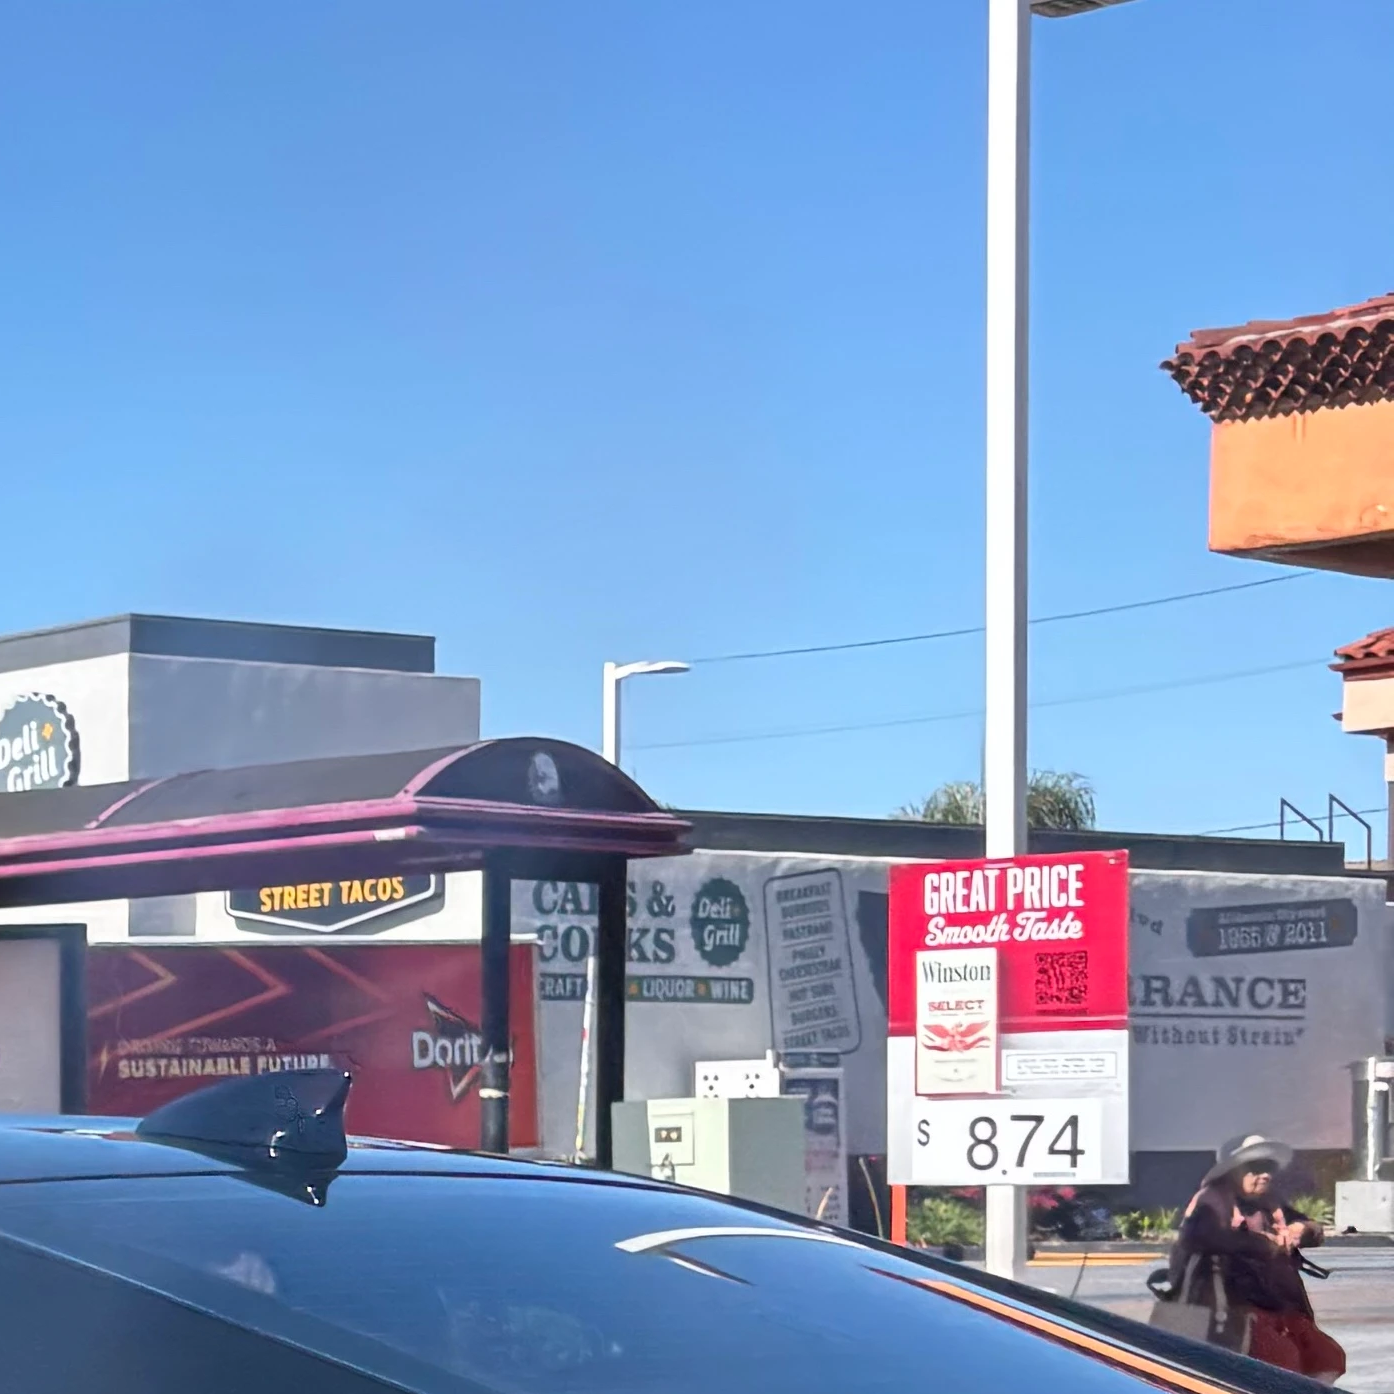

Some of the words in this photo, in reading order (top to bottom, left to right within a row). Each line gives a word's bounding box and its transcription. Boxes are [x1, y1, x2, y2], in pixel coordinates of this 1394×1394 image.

[7, 746, 59, 793] Grill
[259, 882, 332, 912] STREET
[339, 876, 405, 903] TACOS
[646, 880, 676, 918] &
[924, 868, 1000, 915] GREAT
[1006, 864, 1085, 910] PRICE
[698, 896, 732, 919] Deli
[703, 923, 741, 951] Grill
[925, 912, 1011, 946] Smooth
[1013, 911, 1084, 941] Taste
[1285, 921, 1327, 945] 2011
[922, 961, 991, 984] Winston
[642, 980, 695, 1001] LIQUOR
[712, 981, 749, 1000] WINE
[928, 1000, 985, 1012] SELECT
[118, 1056, 250, 1079] SUSTAINABLE
[917, 1119, 931, 1147] $
[966, 1115, 1085, 1175] 8.74
